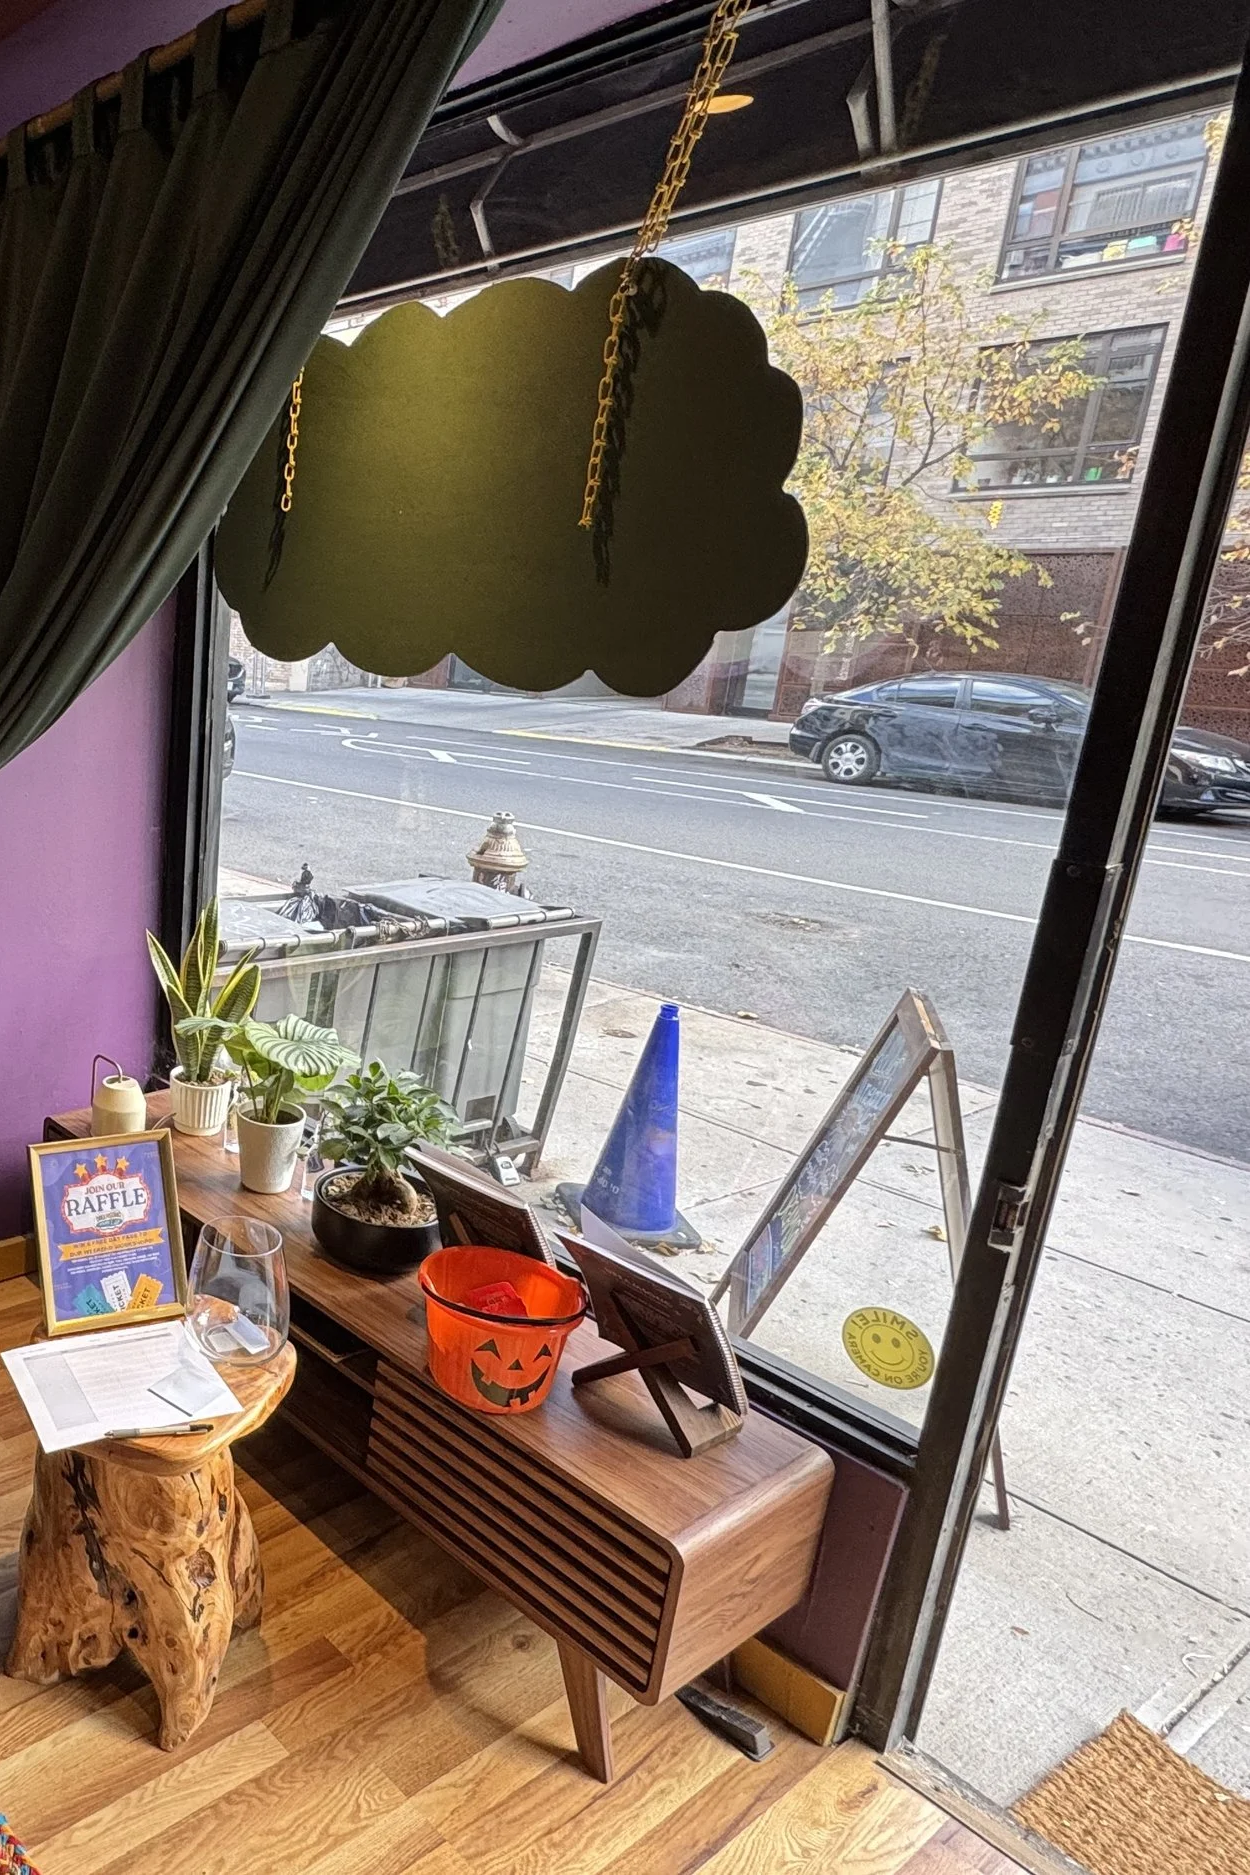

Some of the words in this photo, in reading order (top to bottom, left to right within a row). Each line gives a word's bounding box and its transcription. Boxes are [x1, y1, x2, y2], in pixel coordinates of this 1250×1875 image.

[85, 1183, 105, 1195] JOIN
[106, 1181, 125, 1192] OUR
[65, 1187, 147, 1217] RAFFLE
[112, 1285, 126, 1310] ICKET
